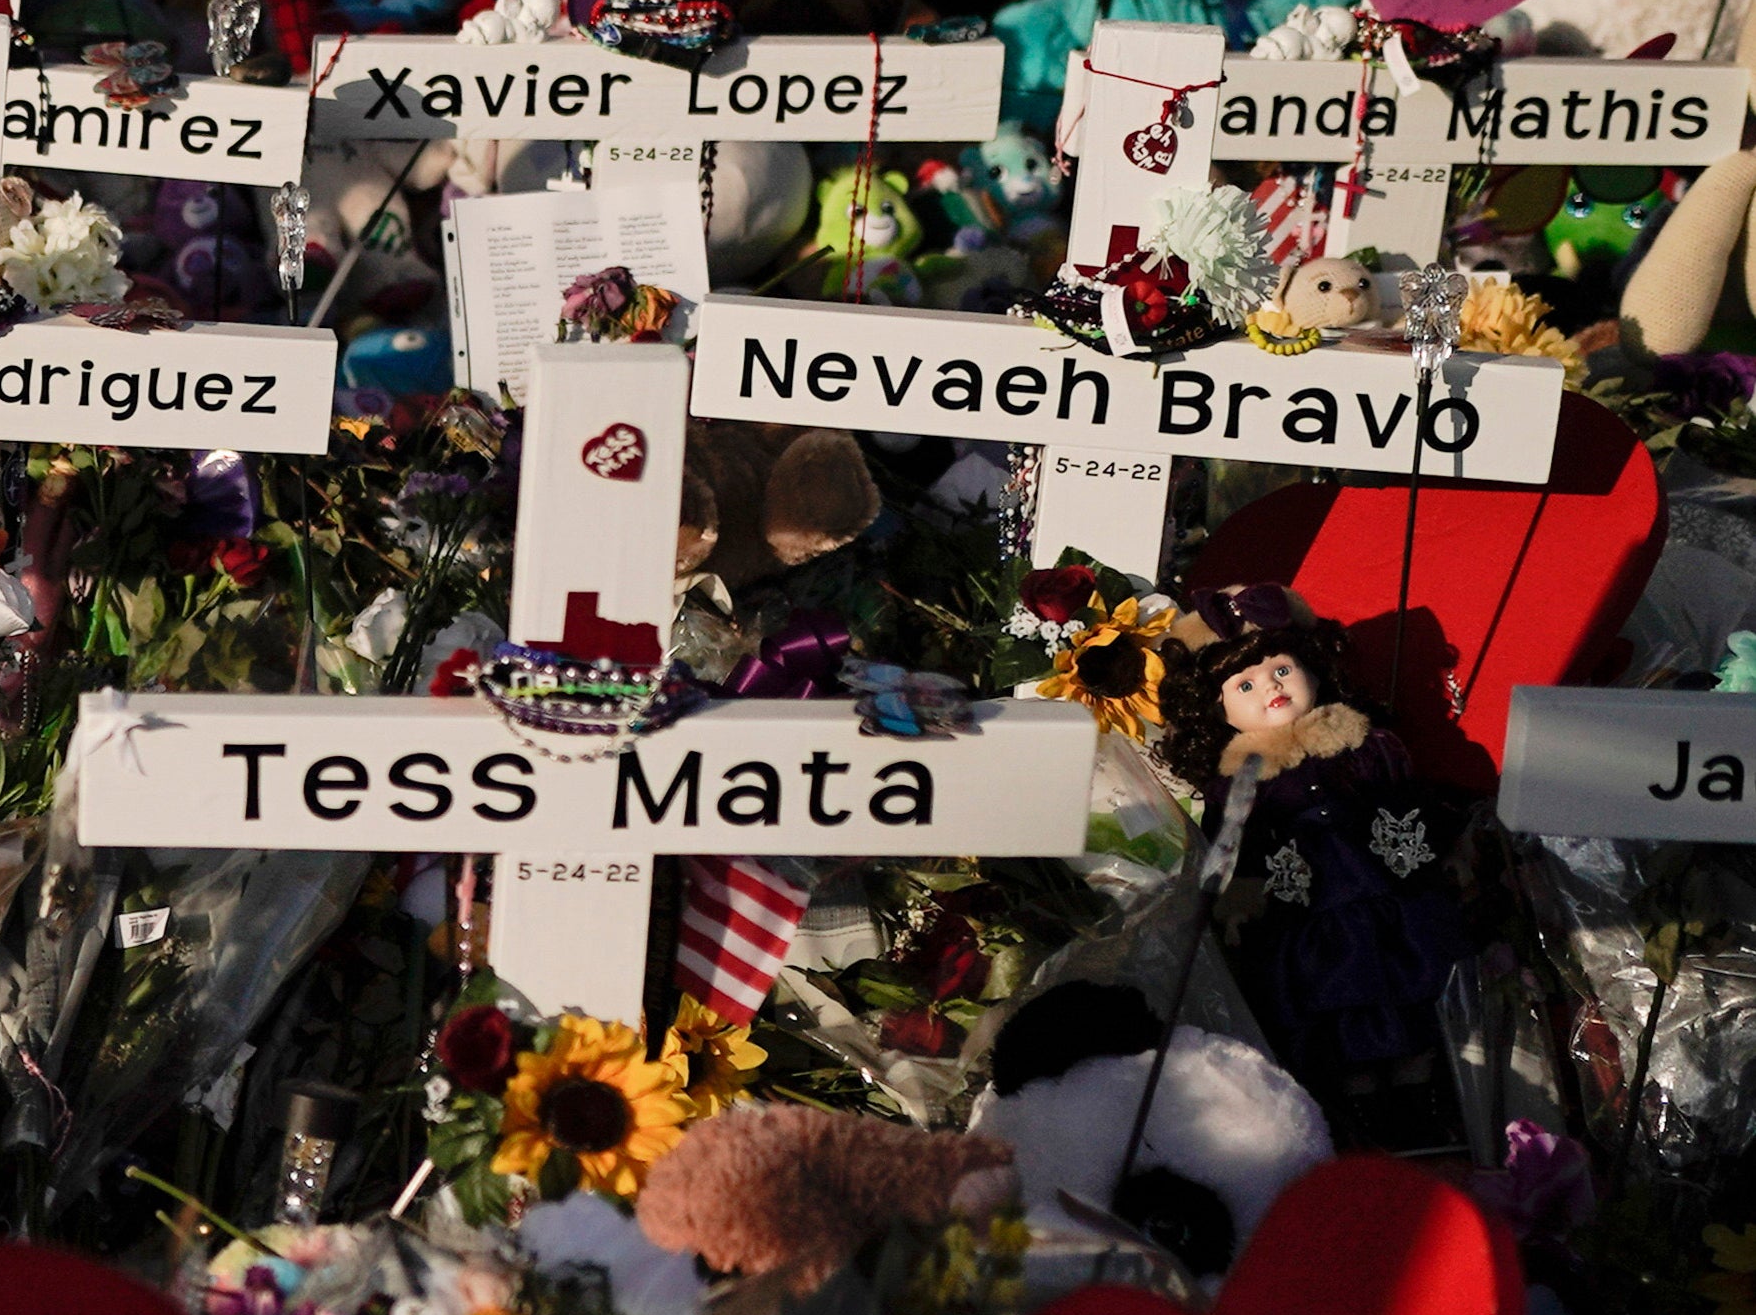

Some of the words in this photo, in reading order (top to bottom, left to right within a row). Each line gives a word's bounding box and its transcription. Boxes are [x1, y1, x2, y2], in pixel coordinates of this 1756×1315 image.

[364, 65, 633, 121] Xavier
[687, 71, 908, 124] Lopez
[1219, 89, 1398, 139] anda
[1446, 89, 1709, 143] Mathis
[3, 97, 263, 160] amirez
[609, 147, 694, 162] 5-24-22
[738, 337, 1111, 427] Nevaeh
[1158, 370, 1481, 455] Bravo
[1055, 457, 1162, 481] 5-24-22
[222, 743, 537, 823] Tess
[612, 750, 935, 829] Mata
[1647, 740, 1756, 804] Ja
[518, 862, 639, 882] 5-24-22
